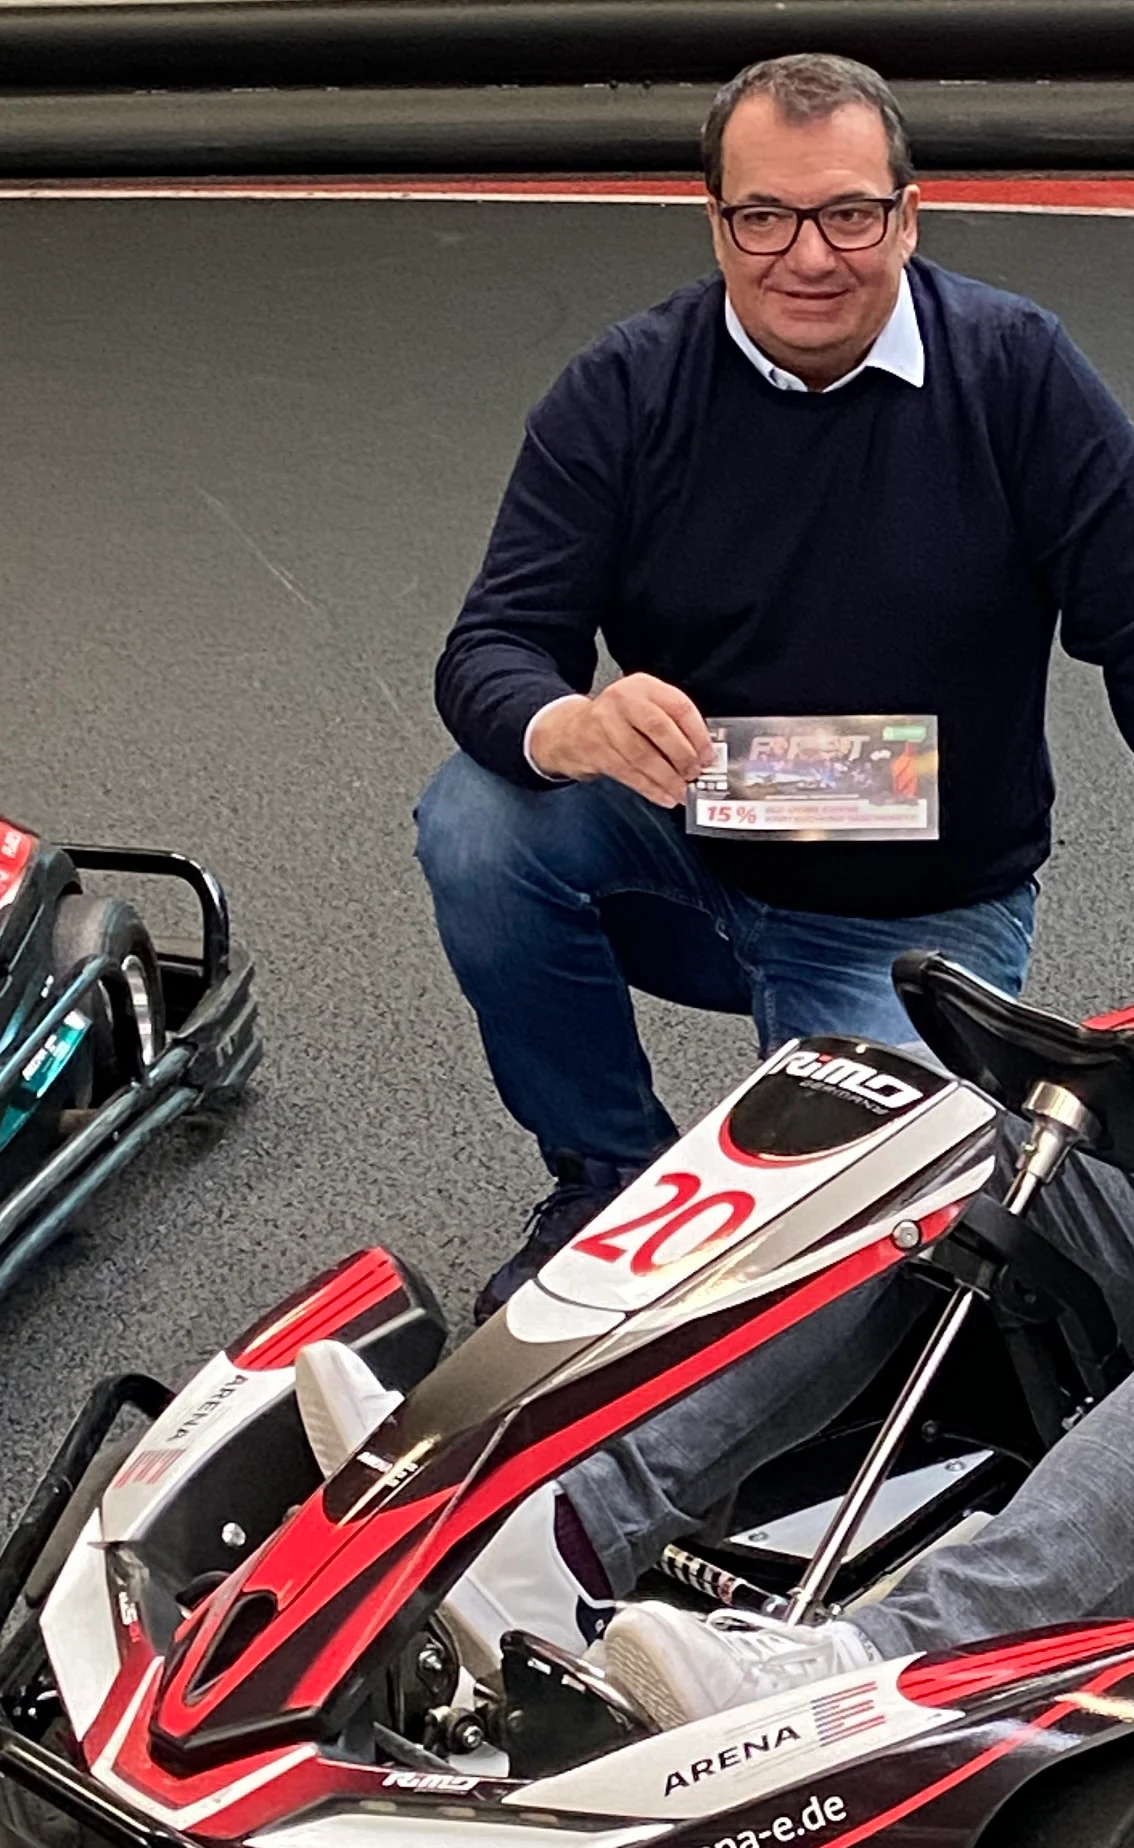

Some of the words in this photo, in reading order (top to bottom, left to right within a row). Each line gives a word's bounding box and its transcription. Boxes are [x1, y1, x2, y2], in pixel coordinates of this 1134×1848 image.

[707, 806, 731, 822] 15
[737, 806, 757, 824] %
[571, 1172, 757, 1278] 20
[166, 1374, 249, 1441] ARENA
[664, 1725, 802, 1797] ARENA
